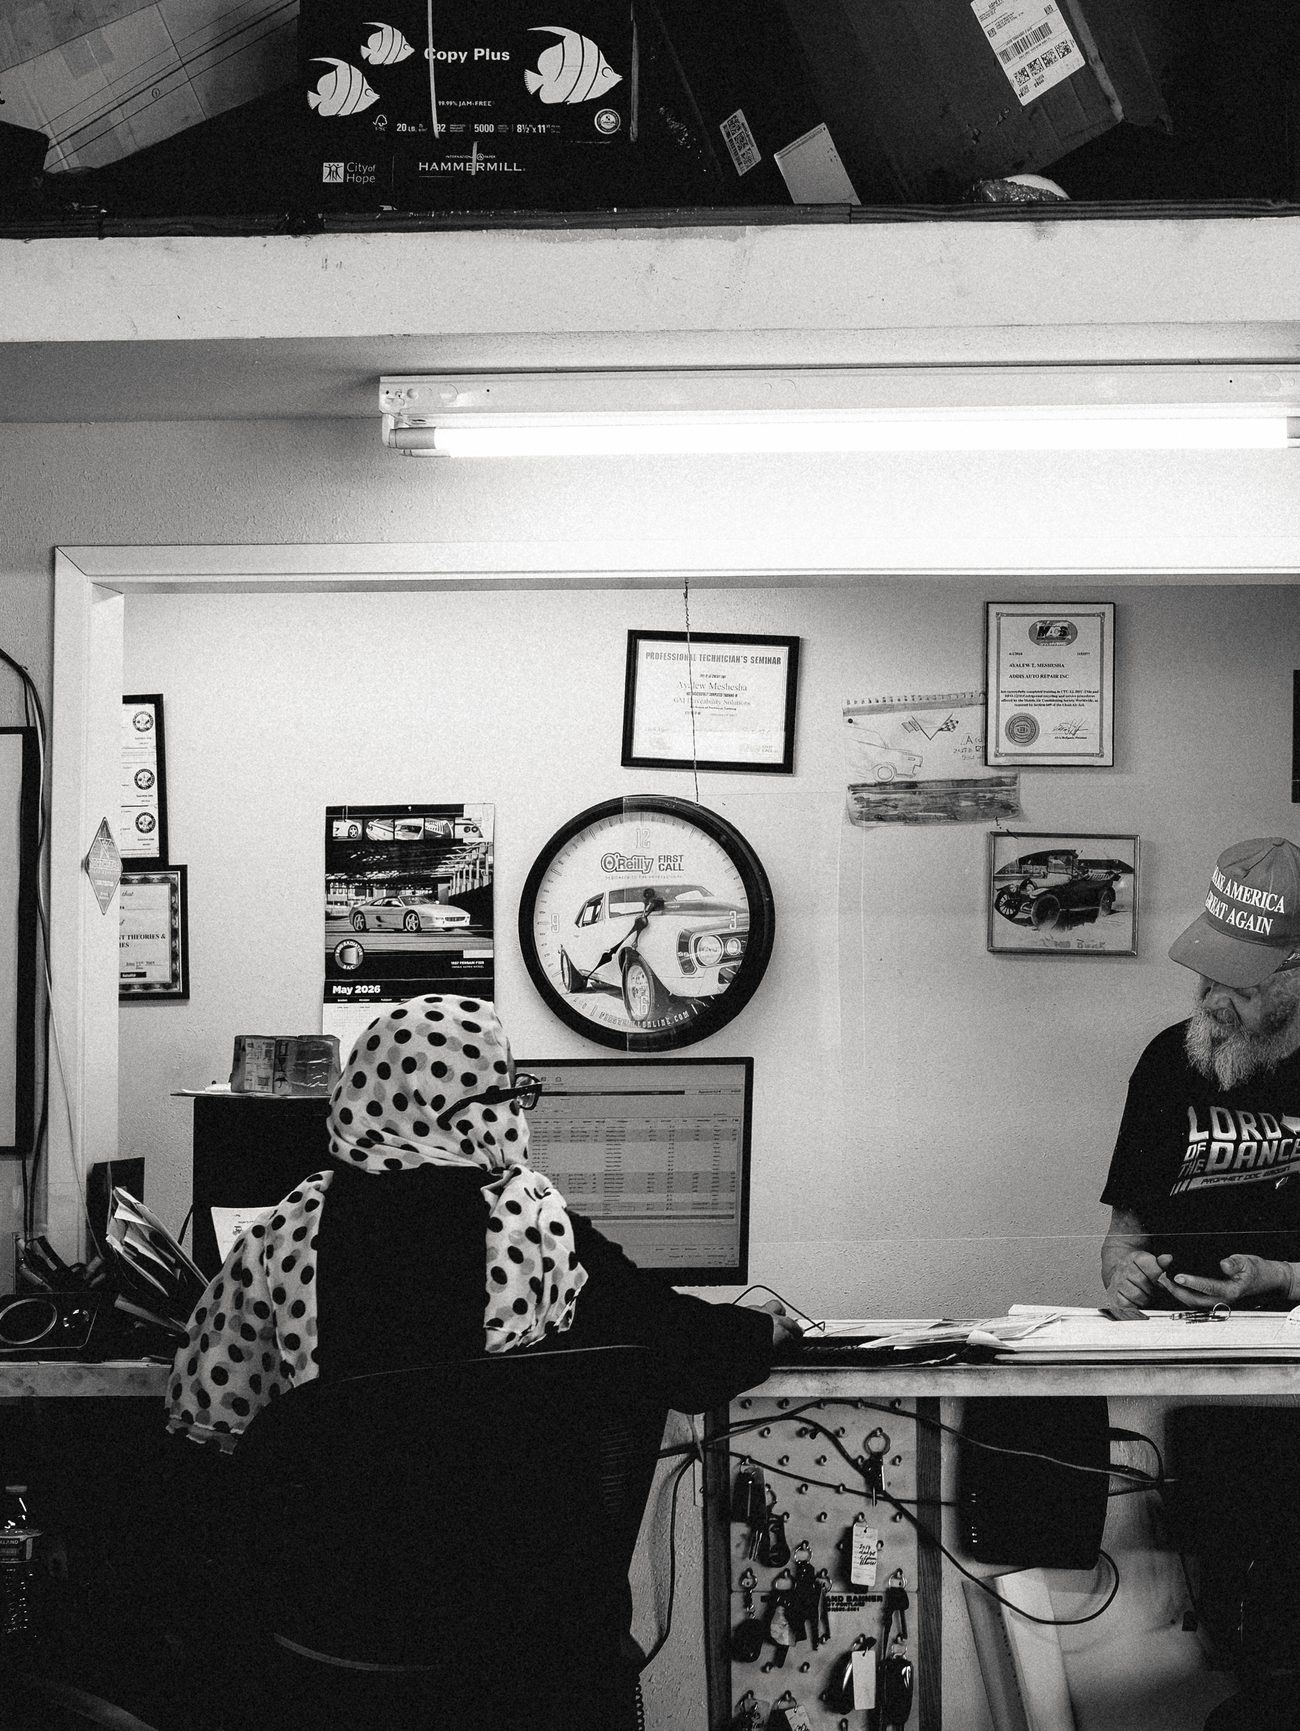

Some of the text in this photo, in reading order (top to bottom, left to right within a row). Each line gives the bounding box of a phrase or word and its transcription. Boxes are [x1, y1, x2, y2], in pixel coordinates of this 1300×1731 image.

[424, 47, 511, 64] Copy Plus
[396, 123, 407, 133] 20
[474, 123, 495, 134] 5000
[345, 162, 376, 175] City of
[418, 162, 523, 172] HAMMERMILL
[346, 173, 376, 185] Hope
[645, 651, 783, 666] PROFESSIONAL TECHNICIAN'S SEMINAR
[601, 853, 654, 874] O'Reilly
[658, 855, 685, 863] FIRST
[658, 863, 685, 872] CALL
[1223, 879, 1285, 914] AMERICA
[1225, 908, 1274, 936] AGAIN
[332, 985, 382, 995] May 2026
[1187, 1105, 1282, 1143] LORD
[1183, 1142, 1207, 1162] OF
[1178, 1158, 1206, 1179] THE
